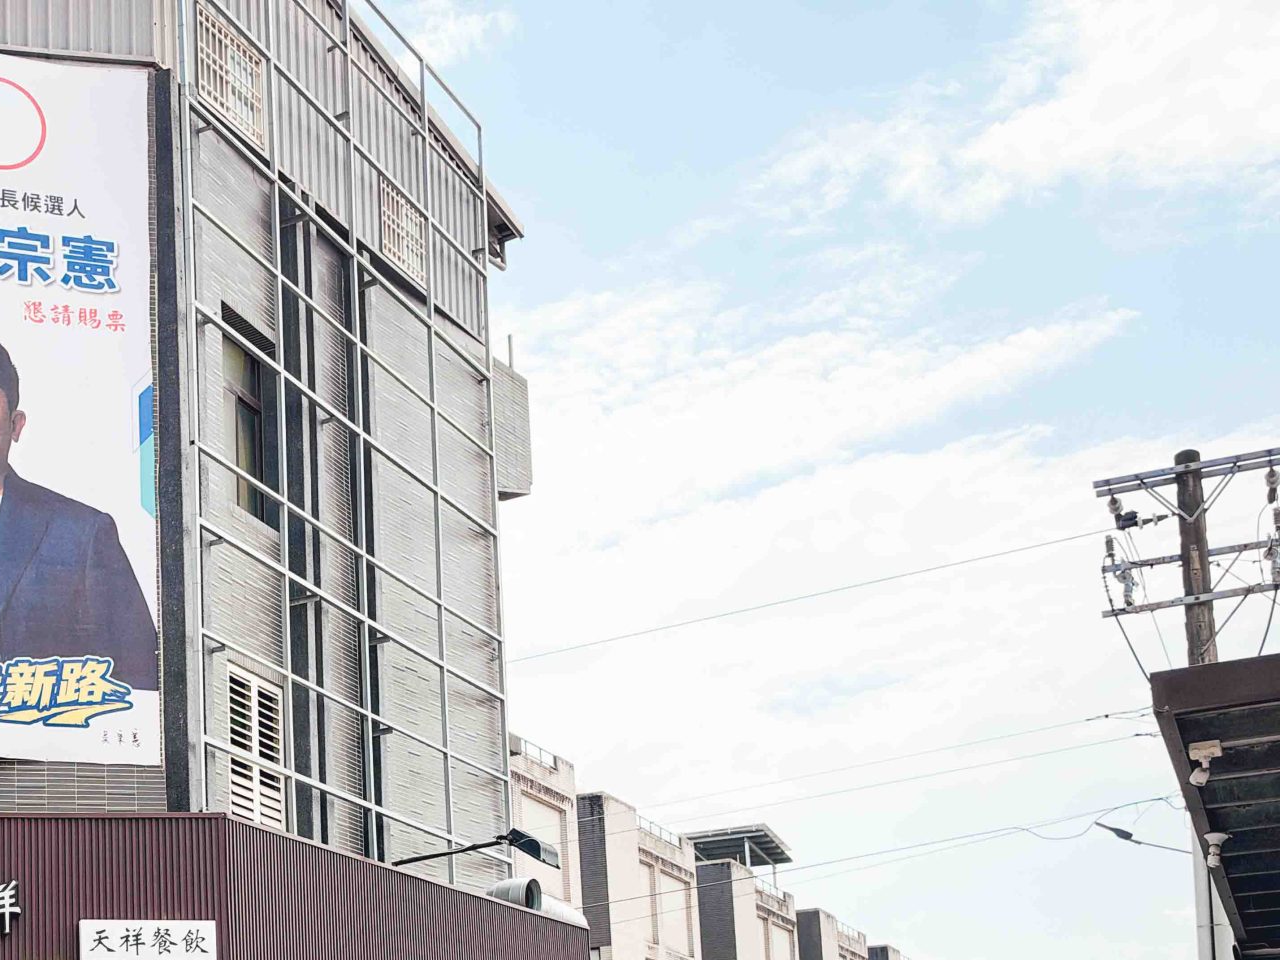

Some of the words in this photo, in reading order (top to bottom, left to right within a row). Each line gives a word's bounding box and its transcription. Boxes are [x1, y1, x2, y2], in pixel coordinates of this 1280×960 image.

[24, 300, 127, 332] 懇請賜票
[89, 926, 210, 955] 天祥餐飲
